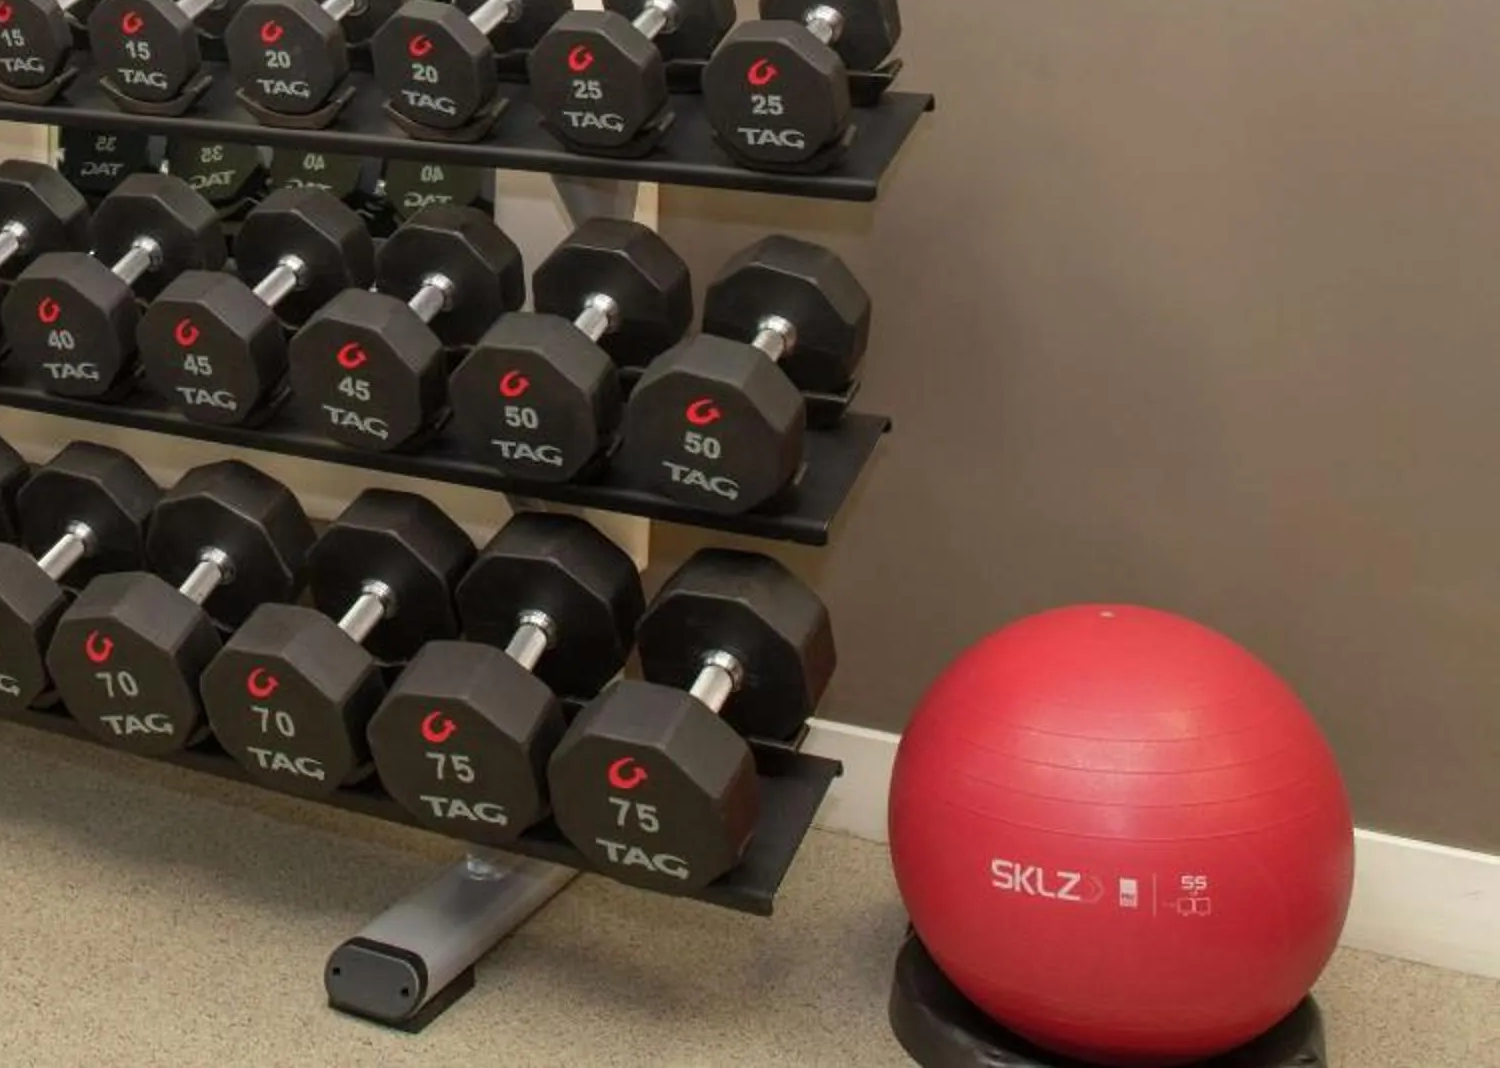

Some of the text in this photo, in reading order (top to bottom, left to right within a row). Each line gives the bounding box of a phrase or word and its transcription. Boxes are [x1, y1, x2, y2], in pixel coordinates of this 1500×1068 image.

[0, 28, 25, 47] 15
[124, 41, 150, 61] 15
[265, 50, 291, 69] 20
[117, 68, 168, 89] TAG
[411, 63, 438, 84] 20
[257, 79, 310, 98] TAG
[573, 79, 603, 100] 25
[401, 89, 458, 115] TAG
[750, 94, 785, 115] 25
[563, 111, 626, 132] TAG
[737, 127, 805, 149] TAG
[48, 330, 76, 350] 40
[42, 362, 99, 381] TAG
[183, 354, 213, 376] 45
[176, 386, 237, 411] TAG
[338, 375, 371, 402] 45
[322, 404, 389, 440] TAG
[504, 405, 539, 430] 50
[491, 438, 563, 467] TAG
[683, 431, 721, 460] 50
[661, 460, 739, 500] TAG
[95, 670, 139, 699] 70
[100, 712, 174, 737] TAG
[251, 706, 296, 738] 70
[247, 746, 326, 781] TAG
[425, 751, 476, 784] 75
[419, 794, 509, 827] TAG
[608, 796, 660, 833] 75
[595, 838, 691, 881] TAG
[991, 858, 1081, 901] SKLZ
